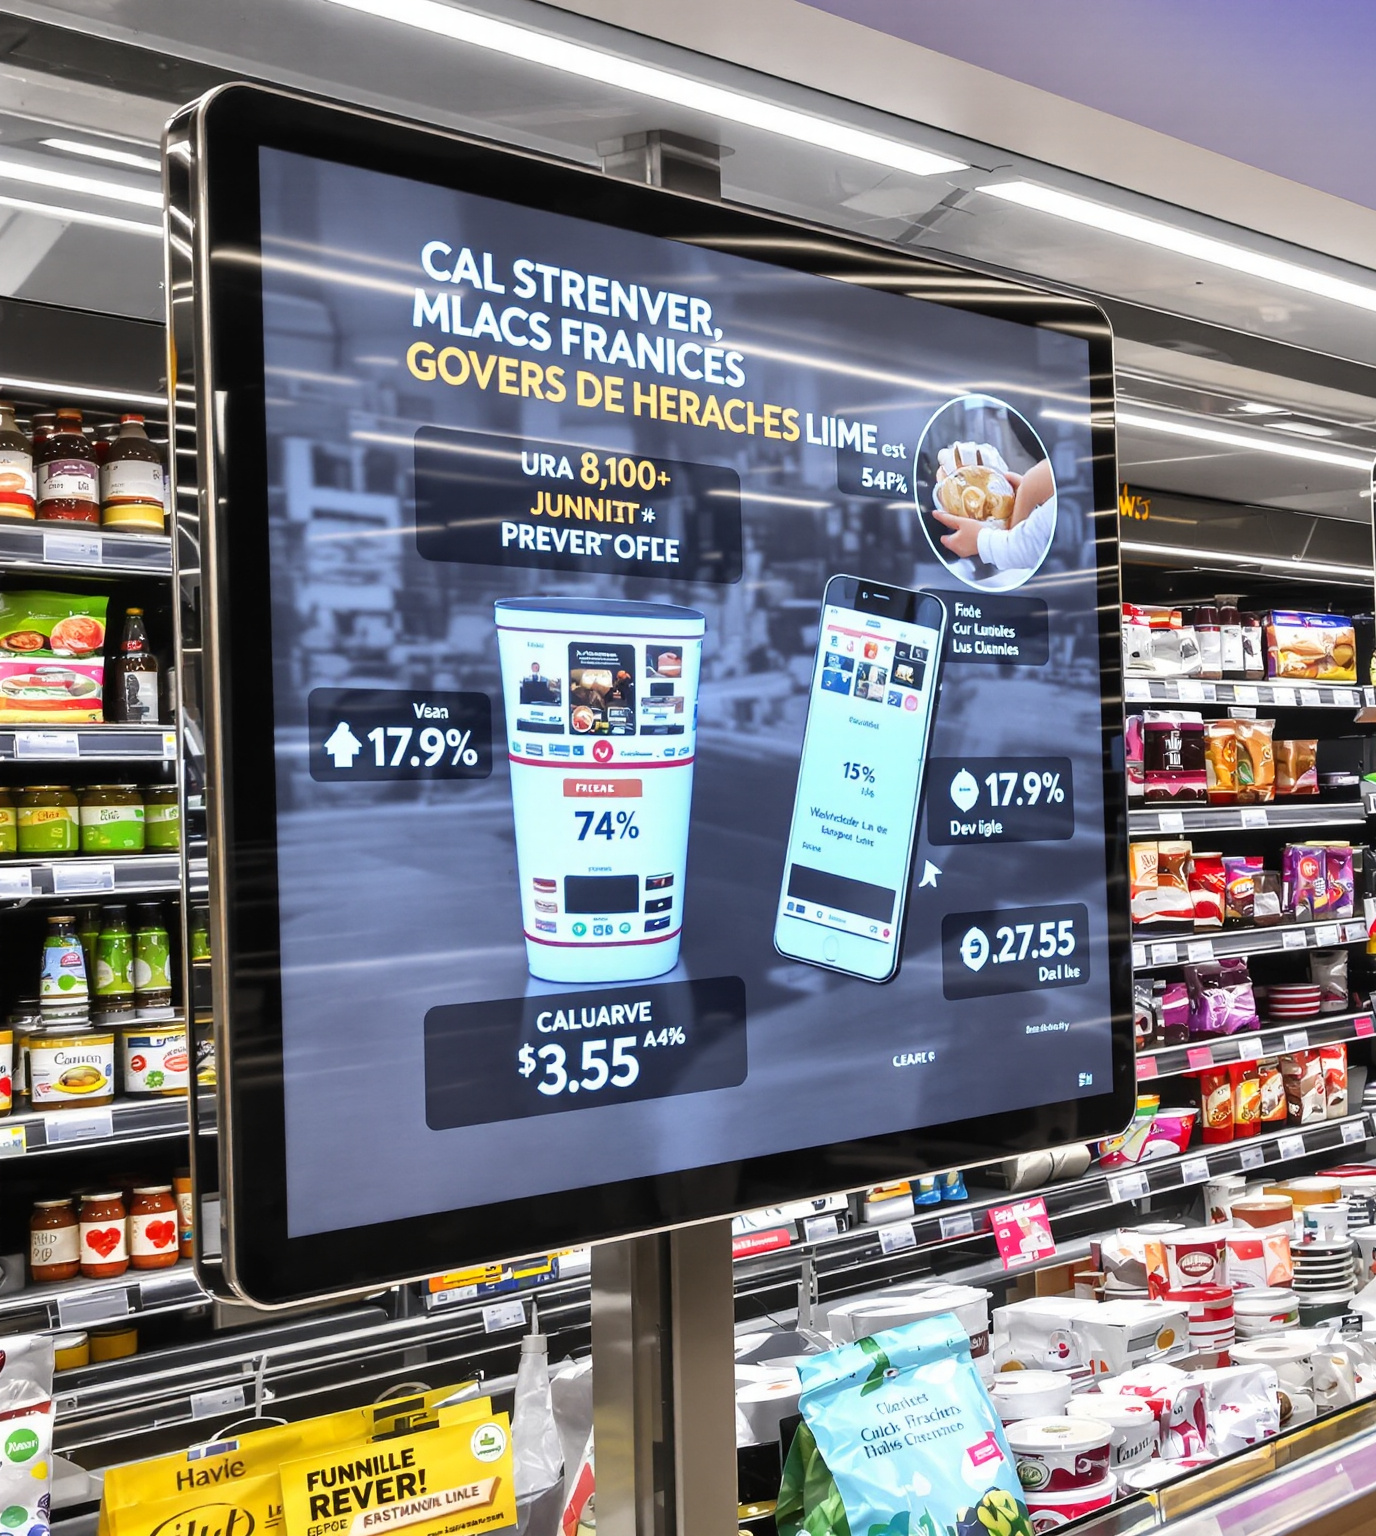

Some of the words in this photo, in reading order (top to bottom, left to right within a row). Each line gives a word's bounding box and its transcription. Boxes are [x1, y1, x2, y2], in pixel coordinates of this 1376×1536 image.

[421, 240, 505, 295] CAL
[513, 261, 723, 341] STRENVER,
[412, 288, 552, 351] MLACS
[406, 342, 567, 403] GOVERS
[576, 371, 624, 413] DE
[521, 451, 574, 480] URA
[580, 452, 671, 491] 8,100+
[367, 725, 479, 768] 17.9%
[843, 761, 876, 783] 15%
[985, 771, 1065, 807] 17.9%
[574, 811, 640, 841] 74%
[950, 819, 977, 836] Dev
[537, 1001, 652, 1034] CALUARVE
[517, 1036, 640, 1097] $3.55
[307, 1447, 416, 1492] FUNNILLE
[310, 1468, 427, 1522] REVER!
